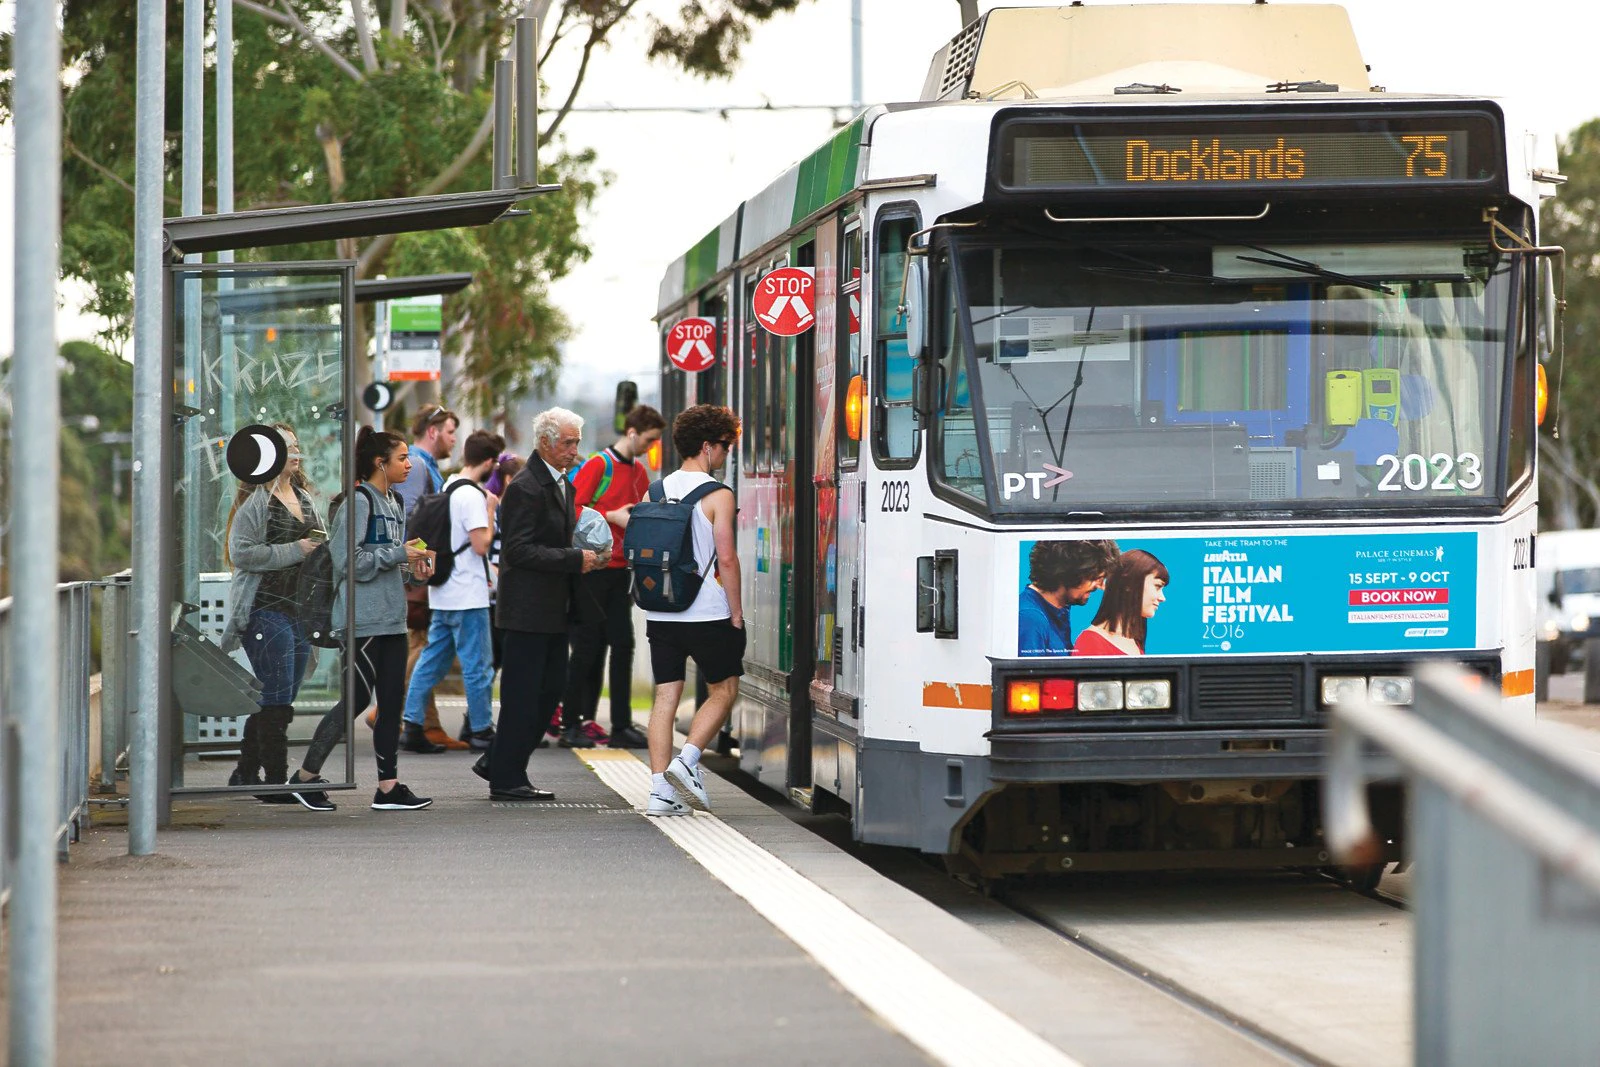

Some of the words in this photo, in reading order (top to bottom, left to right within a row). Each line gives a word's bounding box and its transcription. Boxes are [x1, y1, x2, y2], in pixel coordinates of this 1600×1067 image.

[1126, 138, 1305, 181] Docklands
[1402, 135, 1448, 177] 75
[765, 277, 812, 294] STOP
[675, 325, 713, 340] STOP
[1375, 452, 1482, 491] 2023
[881, 480, 910, 512] 2023
[1240, 539, 1260, 547] TRAM
[1262, 539, 1273, 547] TO
[1274, 538, 1288, 546] THE
[1355, 550, 1389, 558] PALACE
[1392, 549, 1435, 558] CINEMAS
[1203, 565, 1282, 584] ITALIAN
[1349, 573, 1363, 584] 15
[1365, 572, 1398, 584] SEPT
[1408, 571, 1418, 582] 9
[1420, 571, 1450, 583] OCT
[1202, 585, 1252, 604] FILM
[1361, 591, 1400, 603] BOOK
[1403, 590, 1437, 602] NOW
[1202, 604, 1294, 624] FESTIVAL
[1350, 612, 1446, 621] ITALIANFILMFESTIVAL.COM.AU
[1202, 624, 1245, 639] 2016
